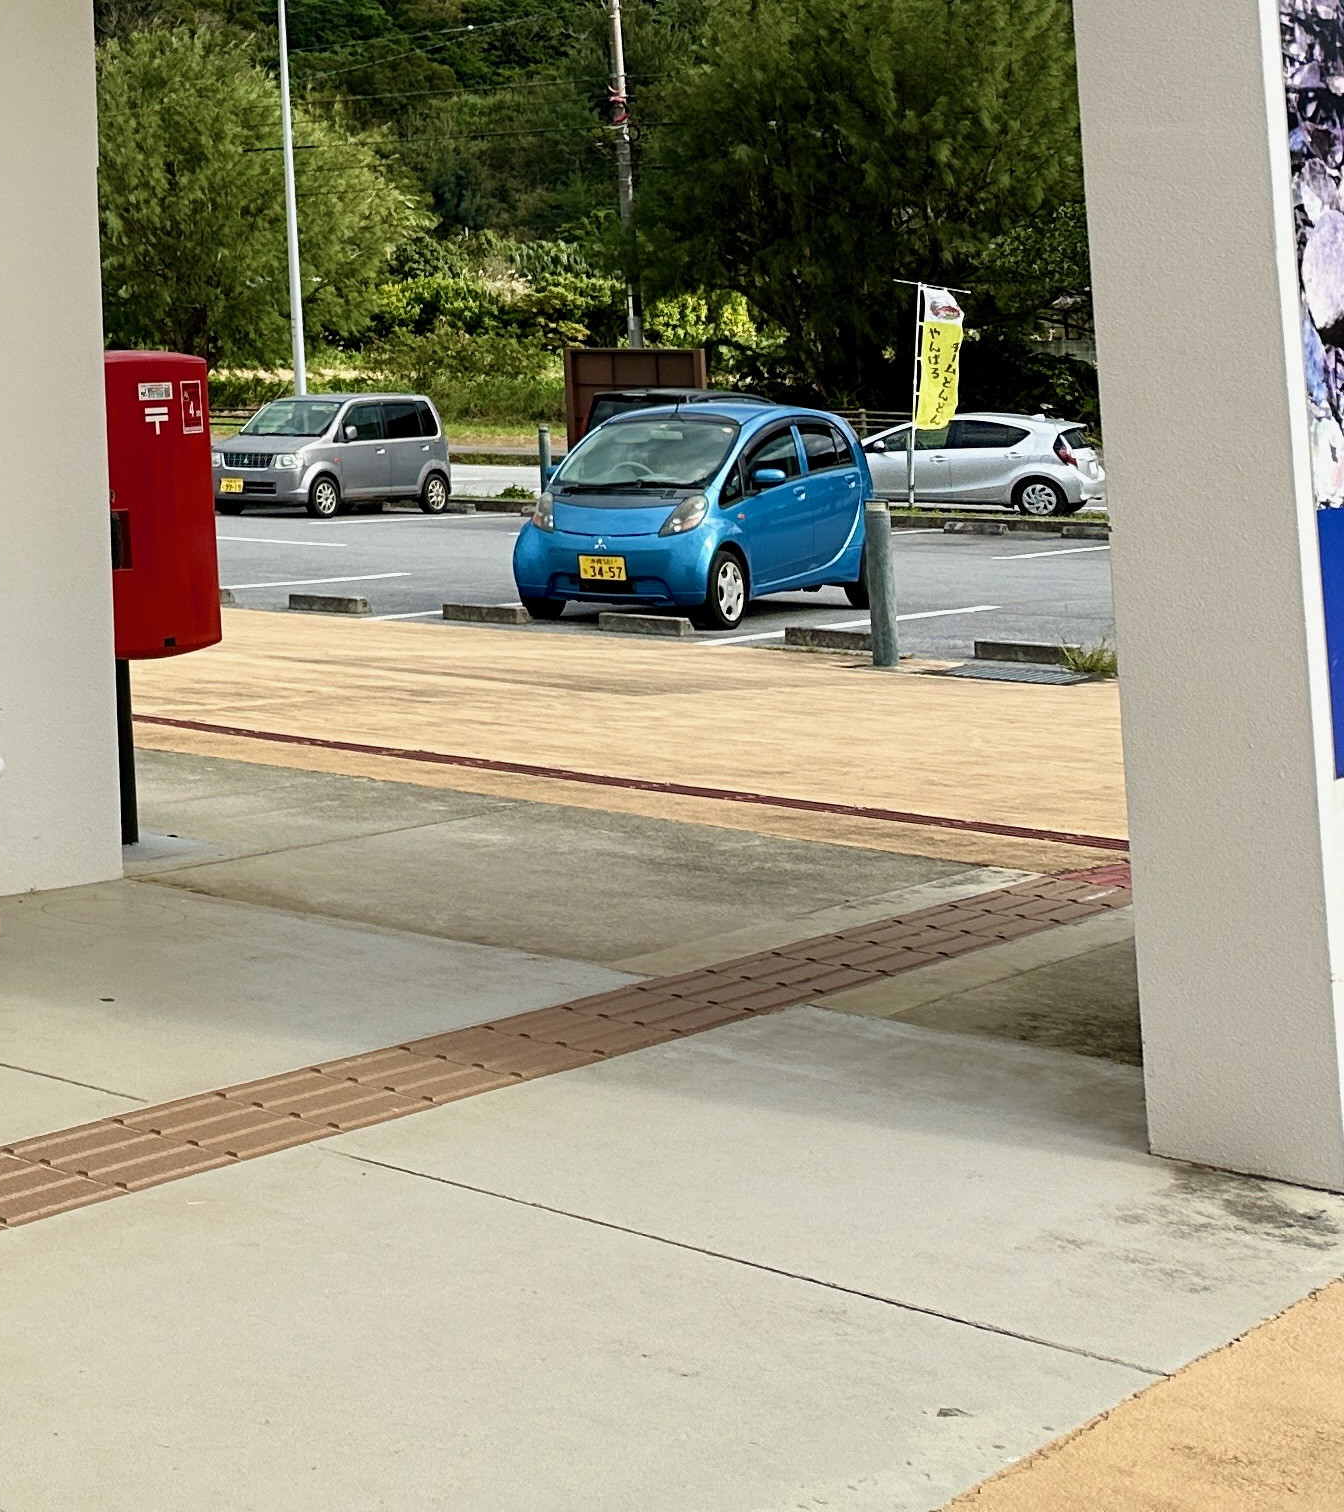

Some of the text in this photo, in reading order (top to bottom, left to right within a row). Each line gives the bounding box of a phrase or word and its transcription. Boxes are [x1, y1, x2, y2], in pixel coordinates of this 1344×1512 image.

[927, 327, 941, 380] やんばる
[929, 342, 960, 426] チームどんどん
[589, 565, 623, 579] 34-57
